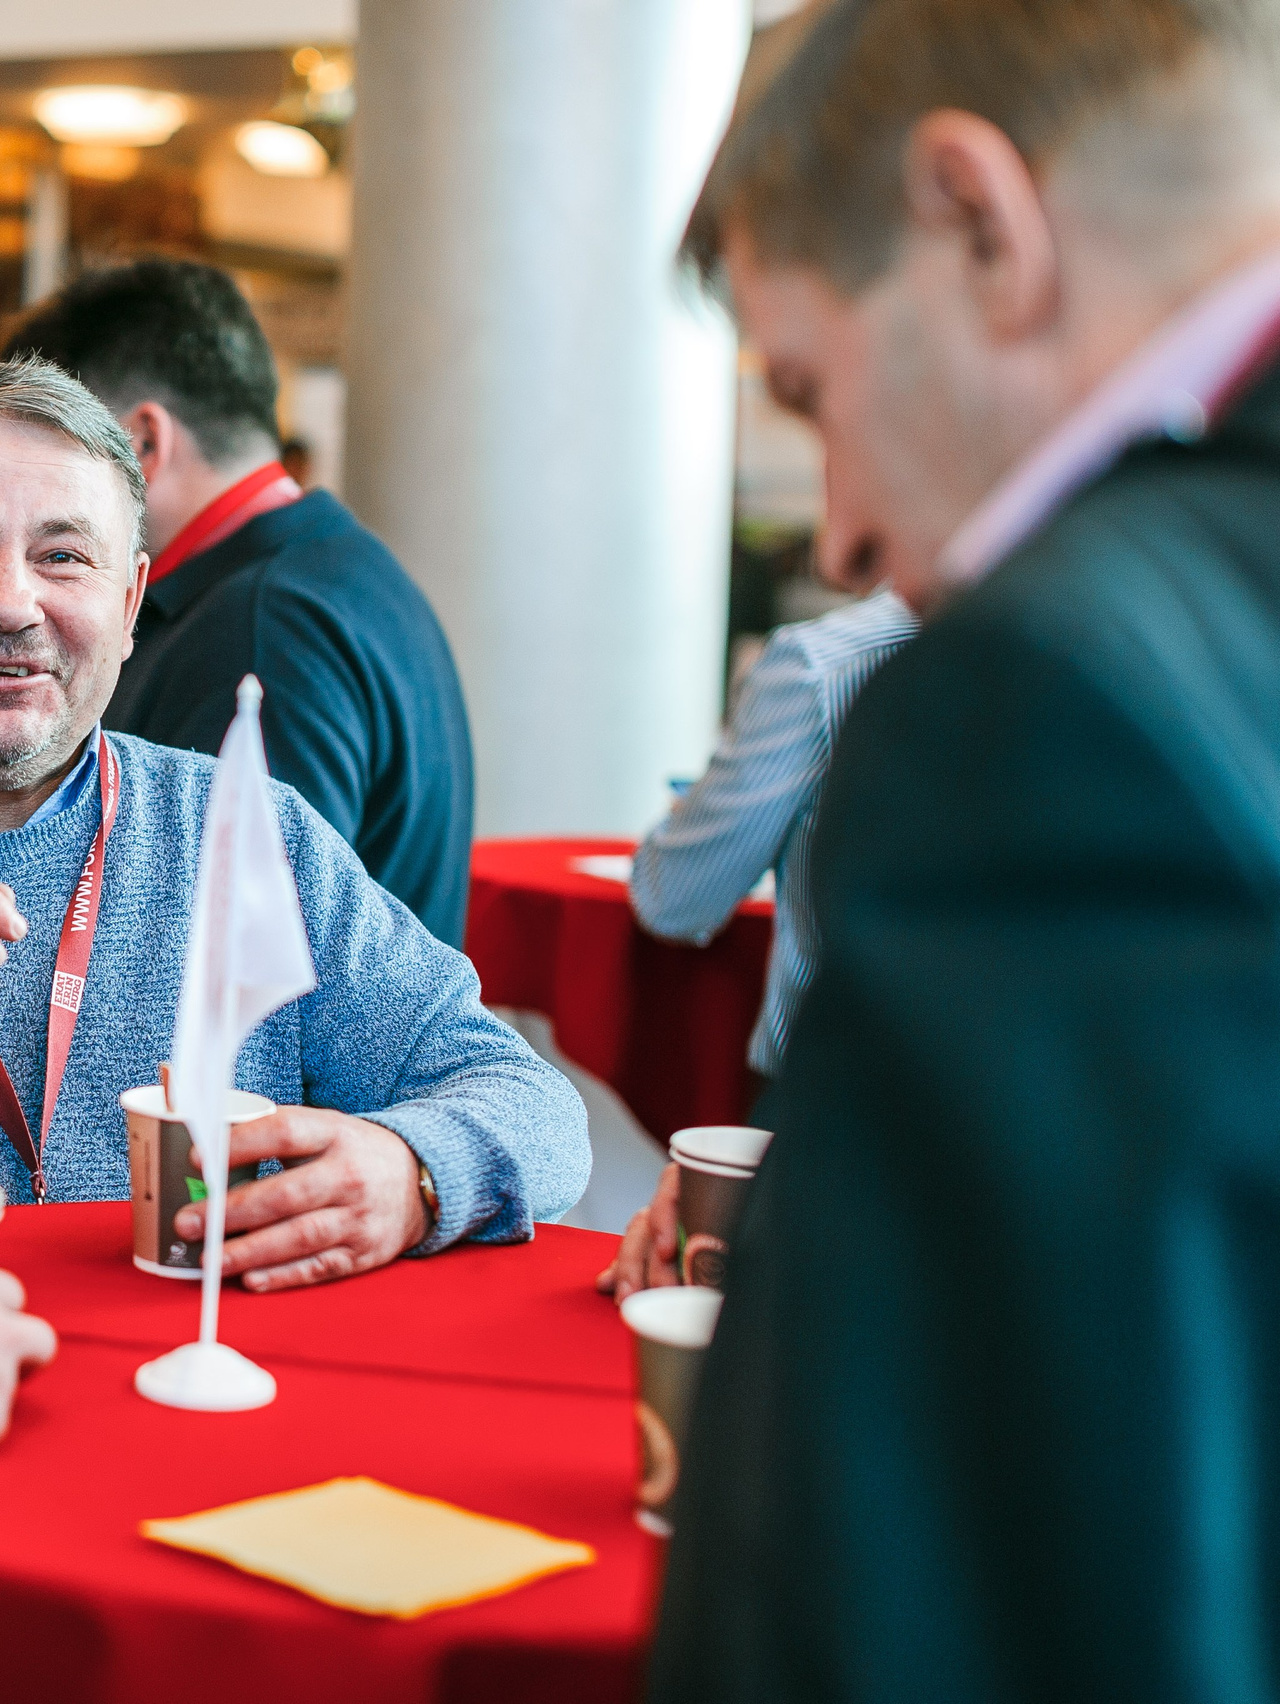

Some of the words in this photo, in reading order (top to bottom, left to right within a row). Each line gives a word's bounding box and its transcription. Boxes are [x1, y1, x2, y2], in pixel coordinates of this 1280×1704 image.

[54, 973, 65, 1004] EKAT
[63, 976, 73, 1007] ERIN
[70, 979, 82, 1010] BURG
